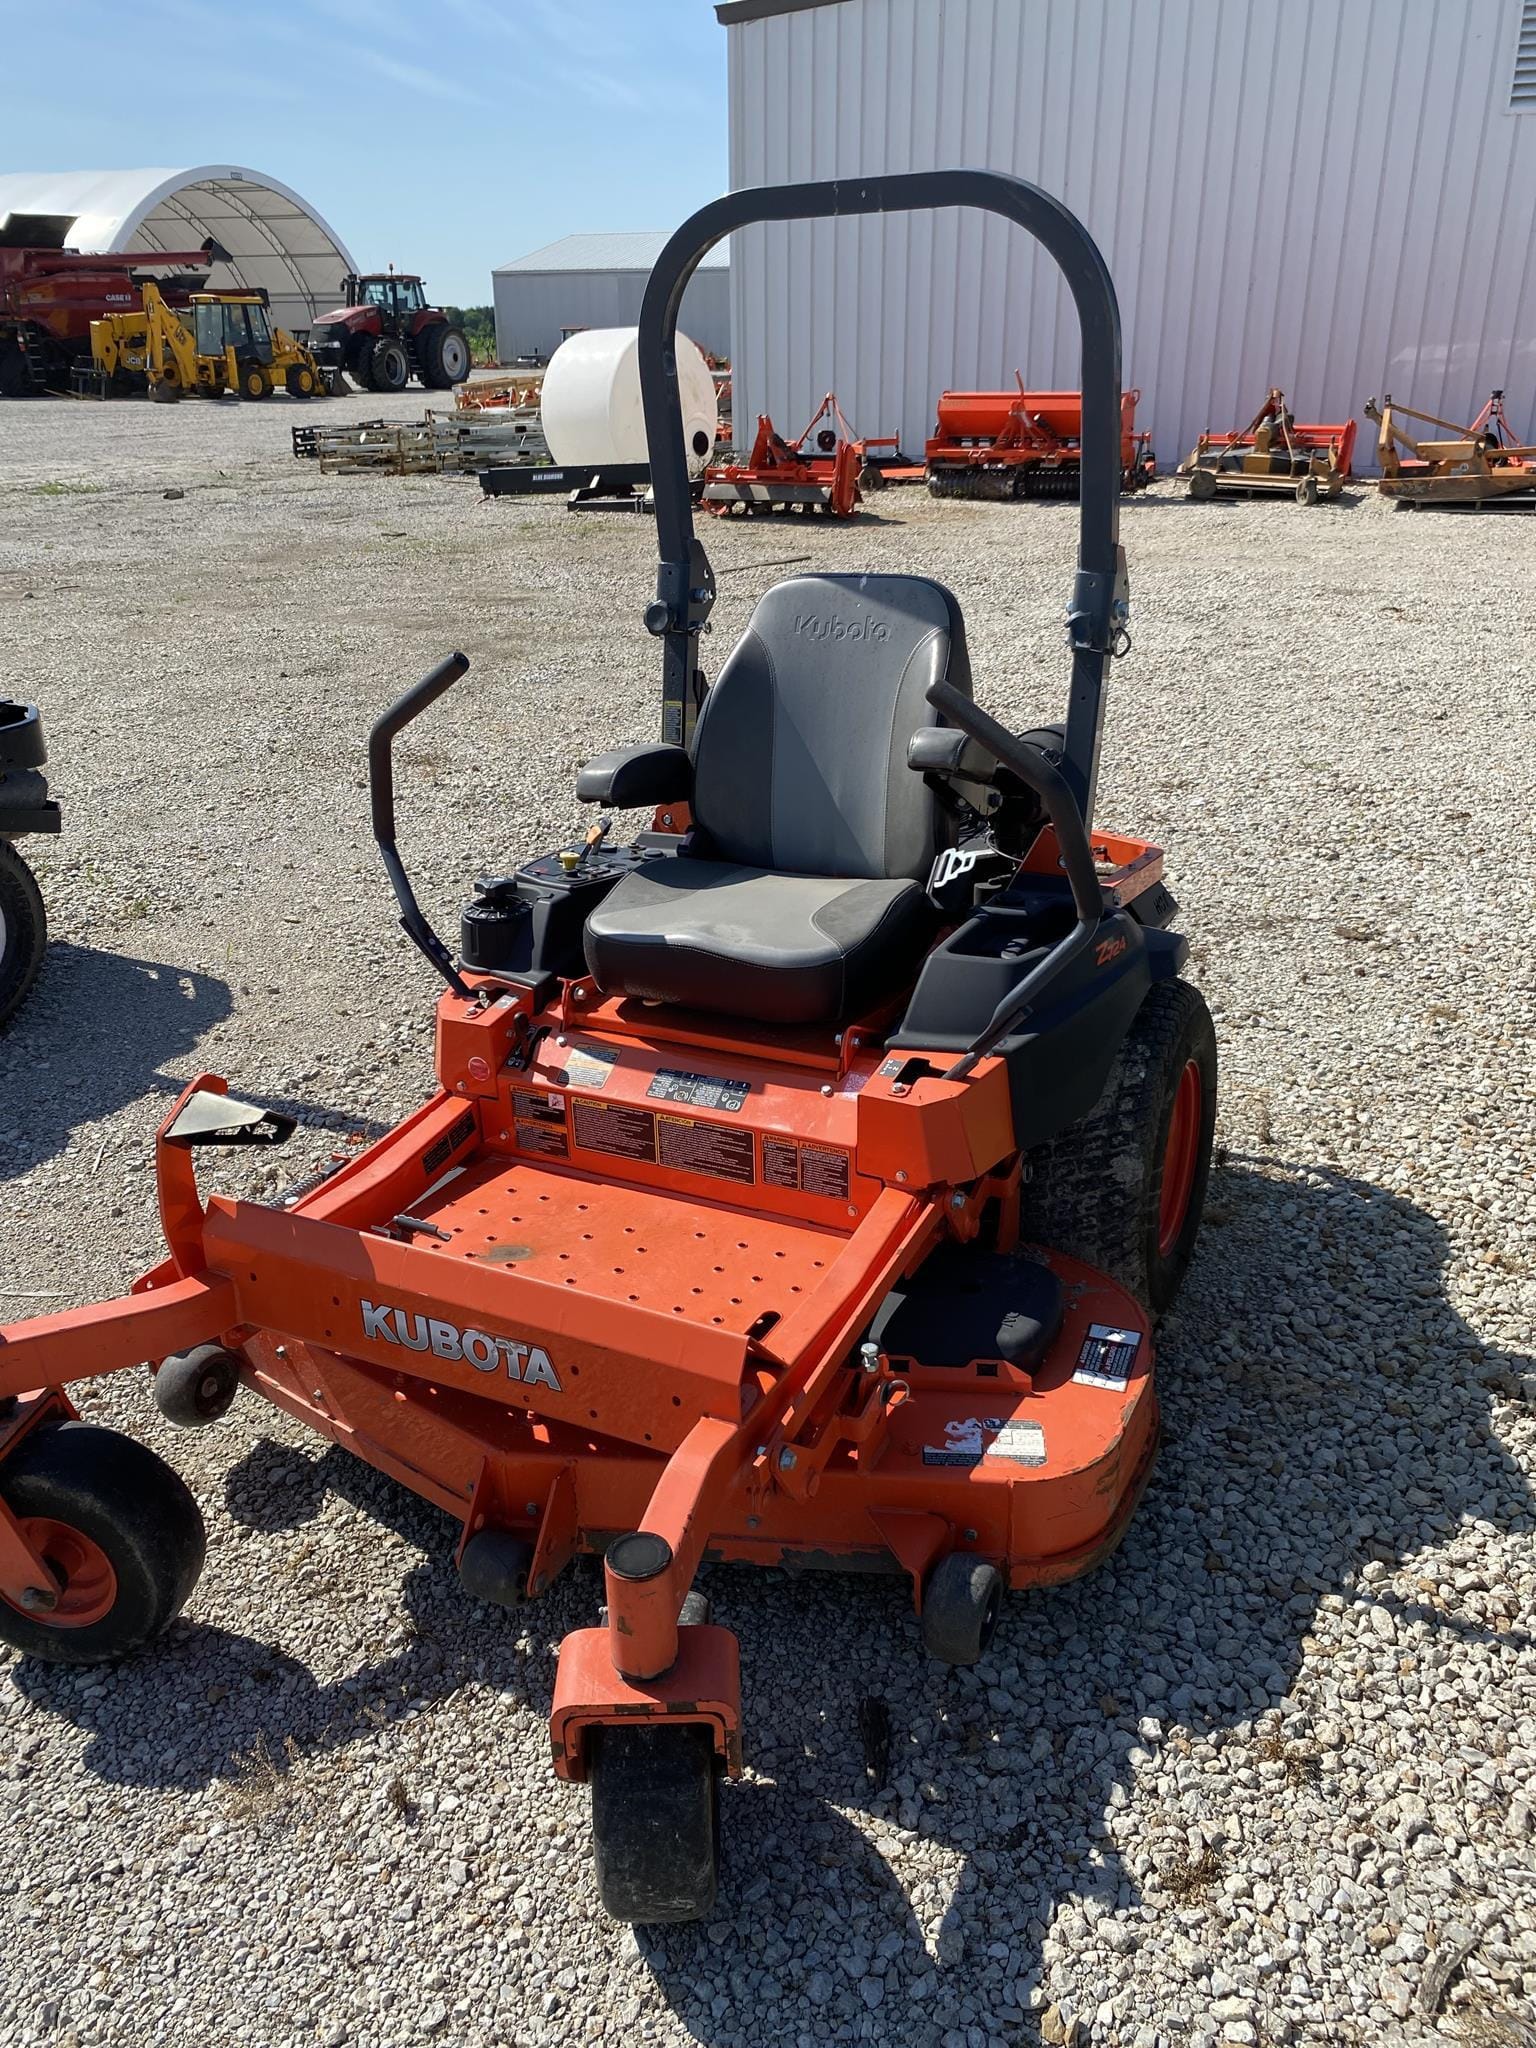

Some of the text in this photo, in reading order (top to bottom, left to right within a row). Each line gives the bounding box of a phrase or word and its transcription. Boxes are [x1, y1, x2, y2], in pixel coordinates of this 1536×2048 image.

[126, 356, 141, 365] JCB
[795, 615, 892, 641] Kubota
[1153, 891, 1169, 916] HOT
[1095, 936, 1127, 966] Z724
[579, 1100, 602, 1108] CAUTION
[807, 1143, 848, 1155] ADVERTENCIA
[360, 1299, 564, 1392] KUBOTA
